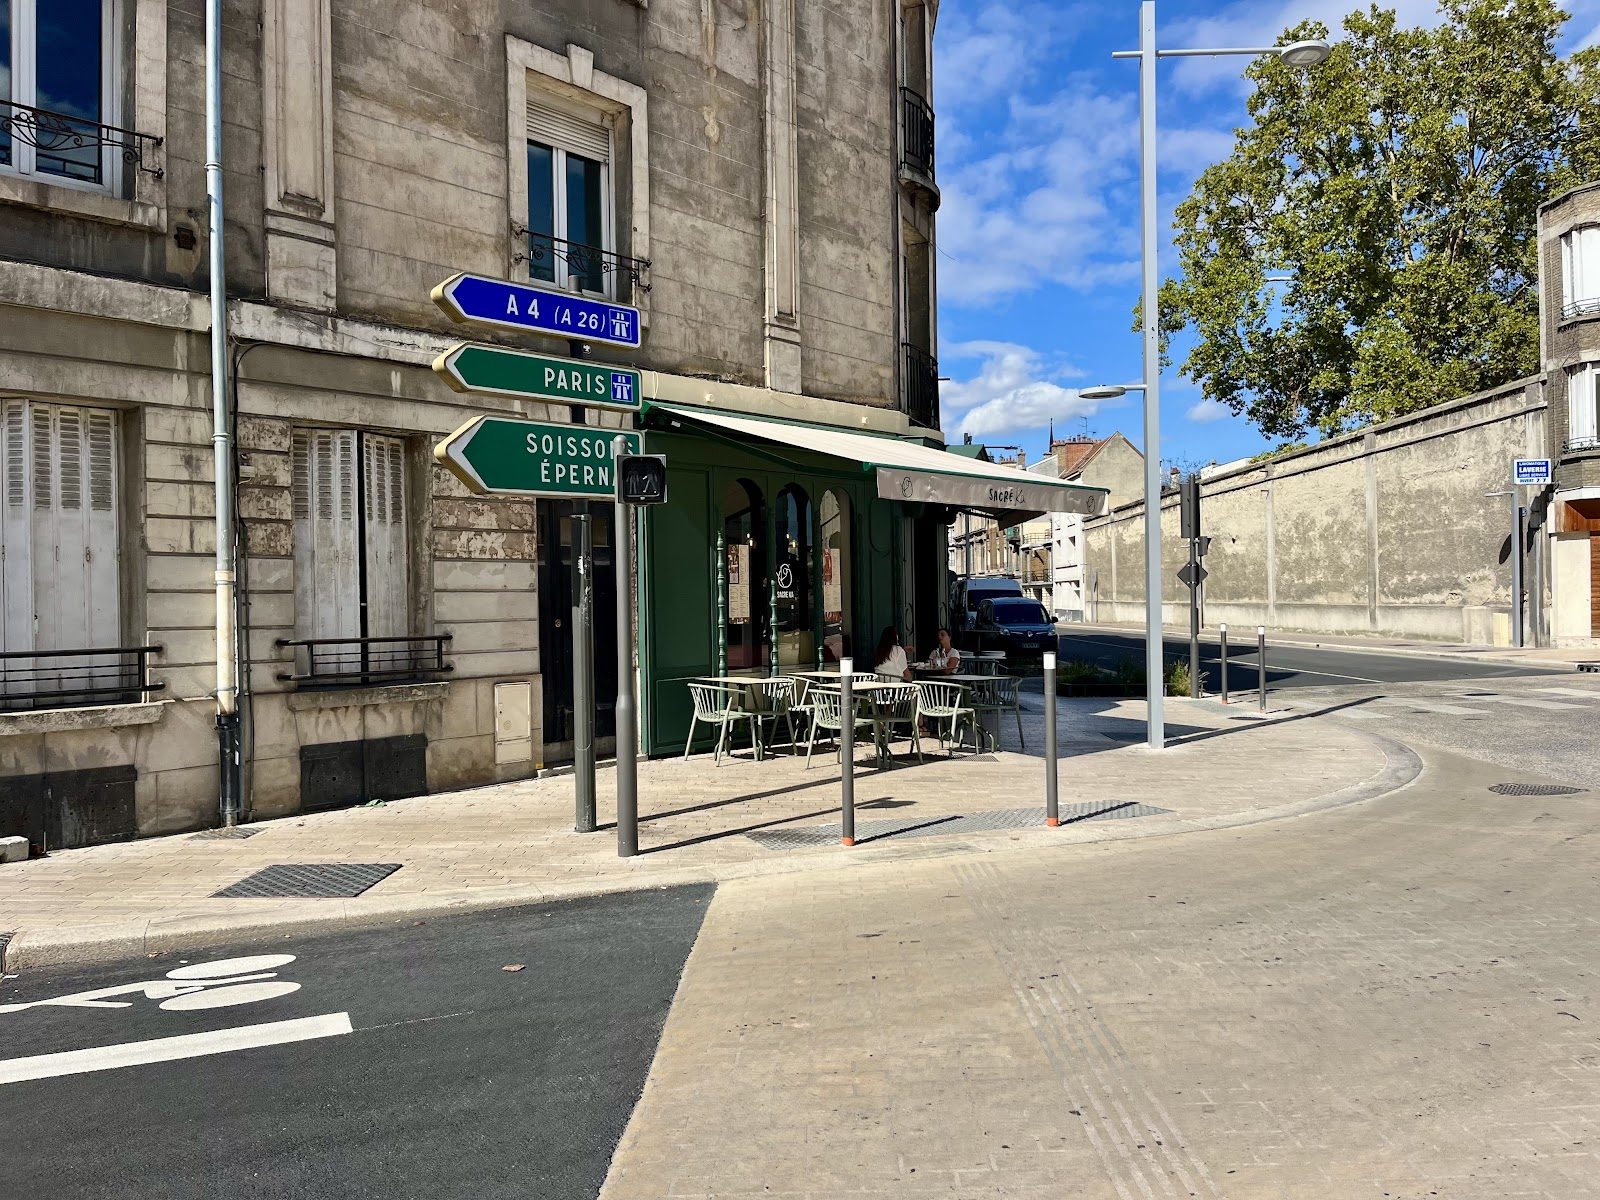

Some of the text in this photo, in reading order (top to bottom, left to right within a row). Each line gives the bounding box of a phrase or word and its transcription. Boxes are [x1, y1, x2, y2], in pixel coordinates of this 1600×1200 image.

[506, 293, 519, 316] A
[527, 298, 540, 319] 4
[577, 311, 606, 333] 26)
[544, 367, 606, 394] PARIS
[540, 458, 615, 486] ÉPERN
[989, 488, 1014, 502] SACRÉ
